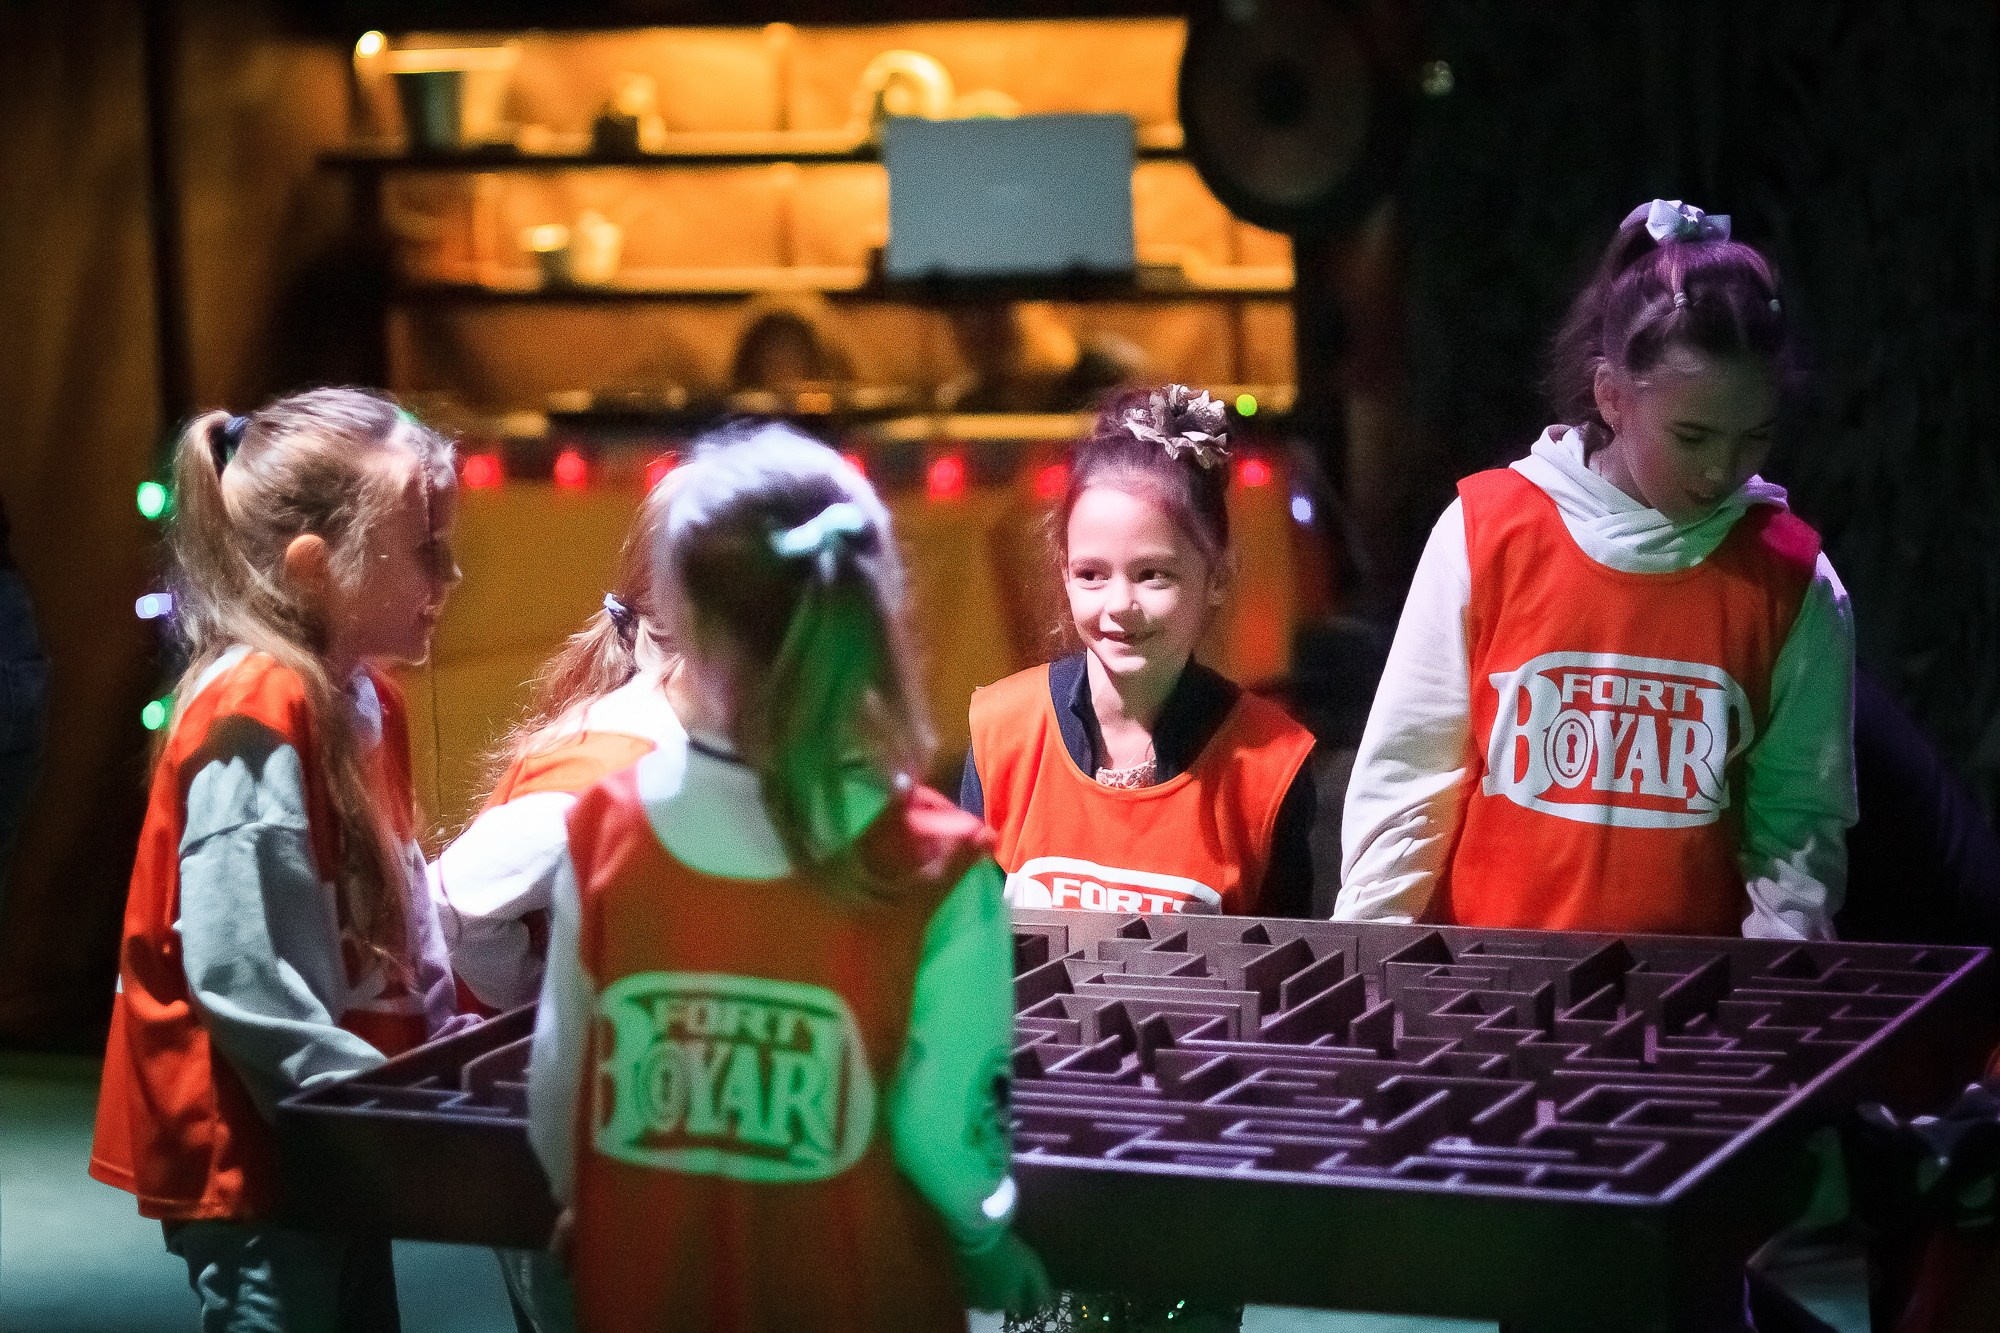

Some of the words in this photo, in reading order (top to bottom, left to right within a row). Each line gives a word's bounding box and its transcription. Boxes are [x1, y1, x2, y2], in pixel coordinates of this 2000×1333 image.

[1561, 673, 1697, 713] FORT
[1482, 668, 1755, 812] BOYARD
[1052, 877, 1174, 914] FORT
[652, 998, 809, 1048] FORT
